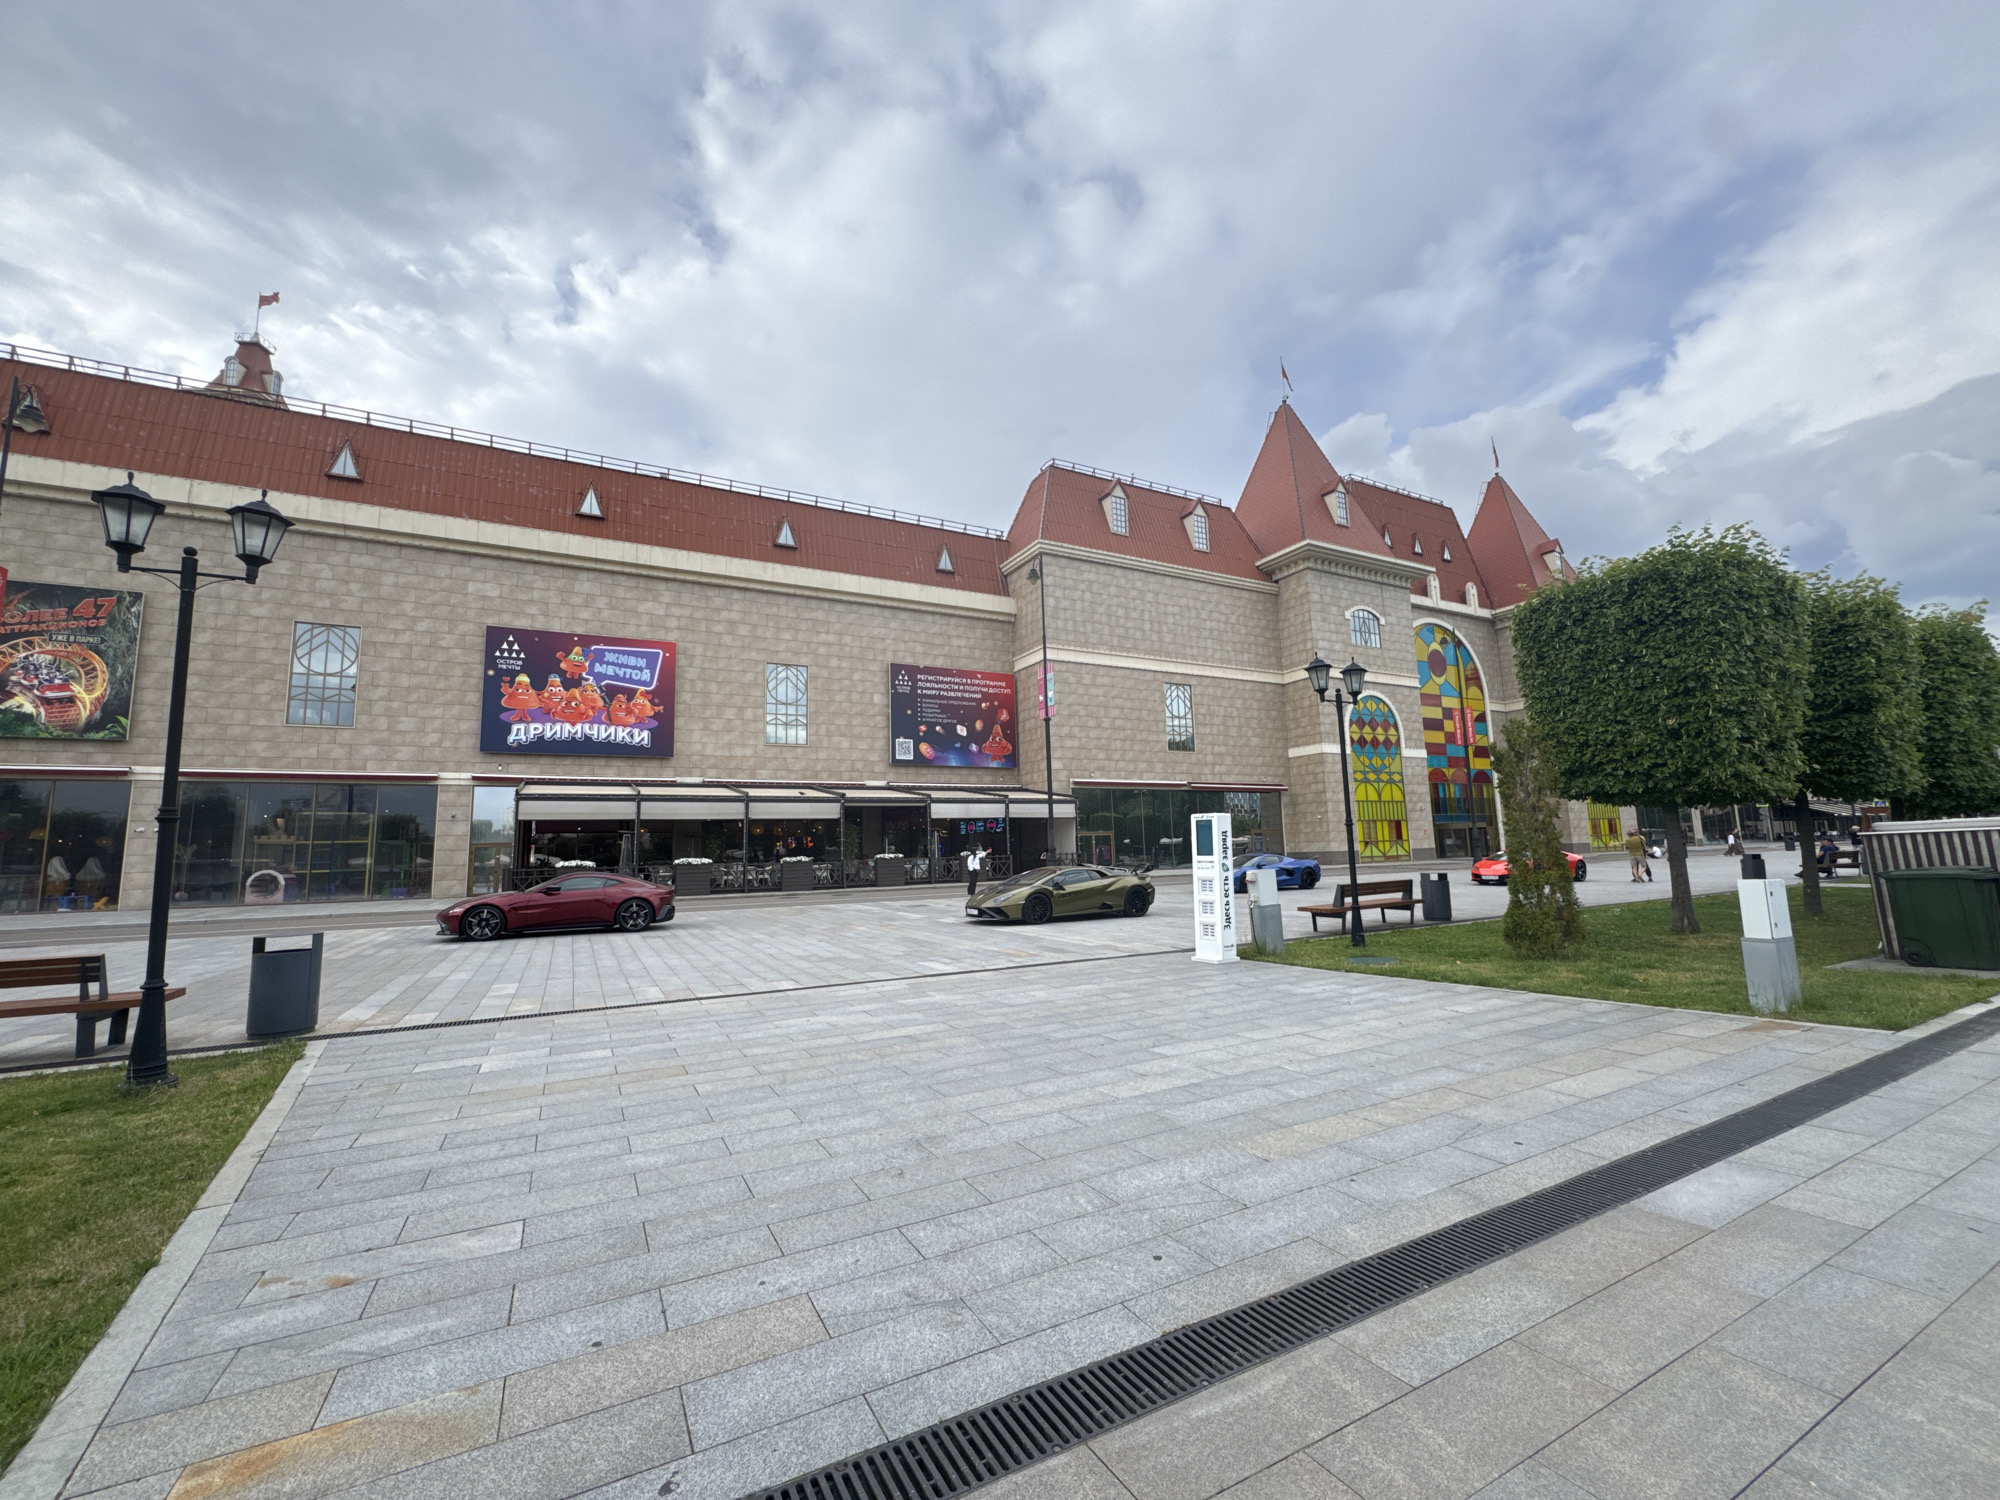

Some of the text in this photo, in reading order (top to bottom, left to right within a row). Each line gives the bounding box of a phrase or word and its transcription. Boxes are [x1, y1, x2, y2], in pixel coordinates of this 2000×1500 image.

[0, 596, 117, 624] ОЛЕЕ 47
[51, 634, 101, 644] УЖЕ В ПАРКЕ!
[496, 658, 523, 666] ОСТРОВ
[604, 651, 647, 668] ЖИВИ
[593, 662, 651, 682] МЕЧТОЙ
[917, 674, 967, 685] РЕГИСТРИРУЙСЯ
[971, 679, 1007, 687] ПРОГРАММЕ
[917, 681, 959, 690] ЛОЯЛЬНОСТИ
[964, 685, 988, 693] ПОЛУЧИ
[940, 690, 982, 698] РАЗВЛЕЧЕНИЙ
[507, 722, 651, 748] ДРИМЧИКИ
[1221, 830, 1230, 861] заряд
[1223, 900, 1232, 931] Здесь
